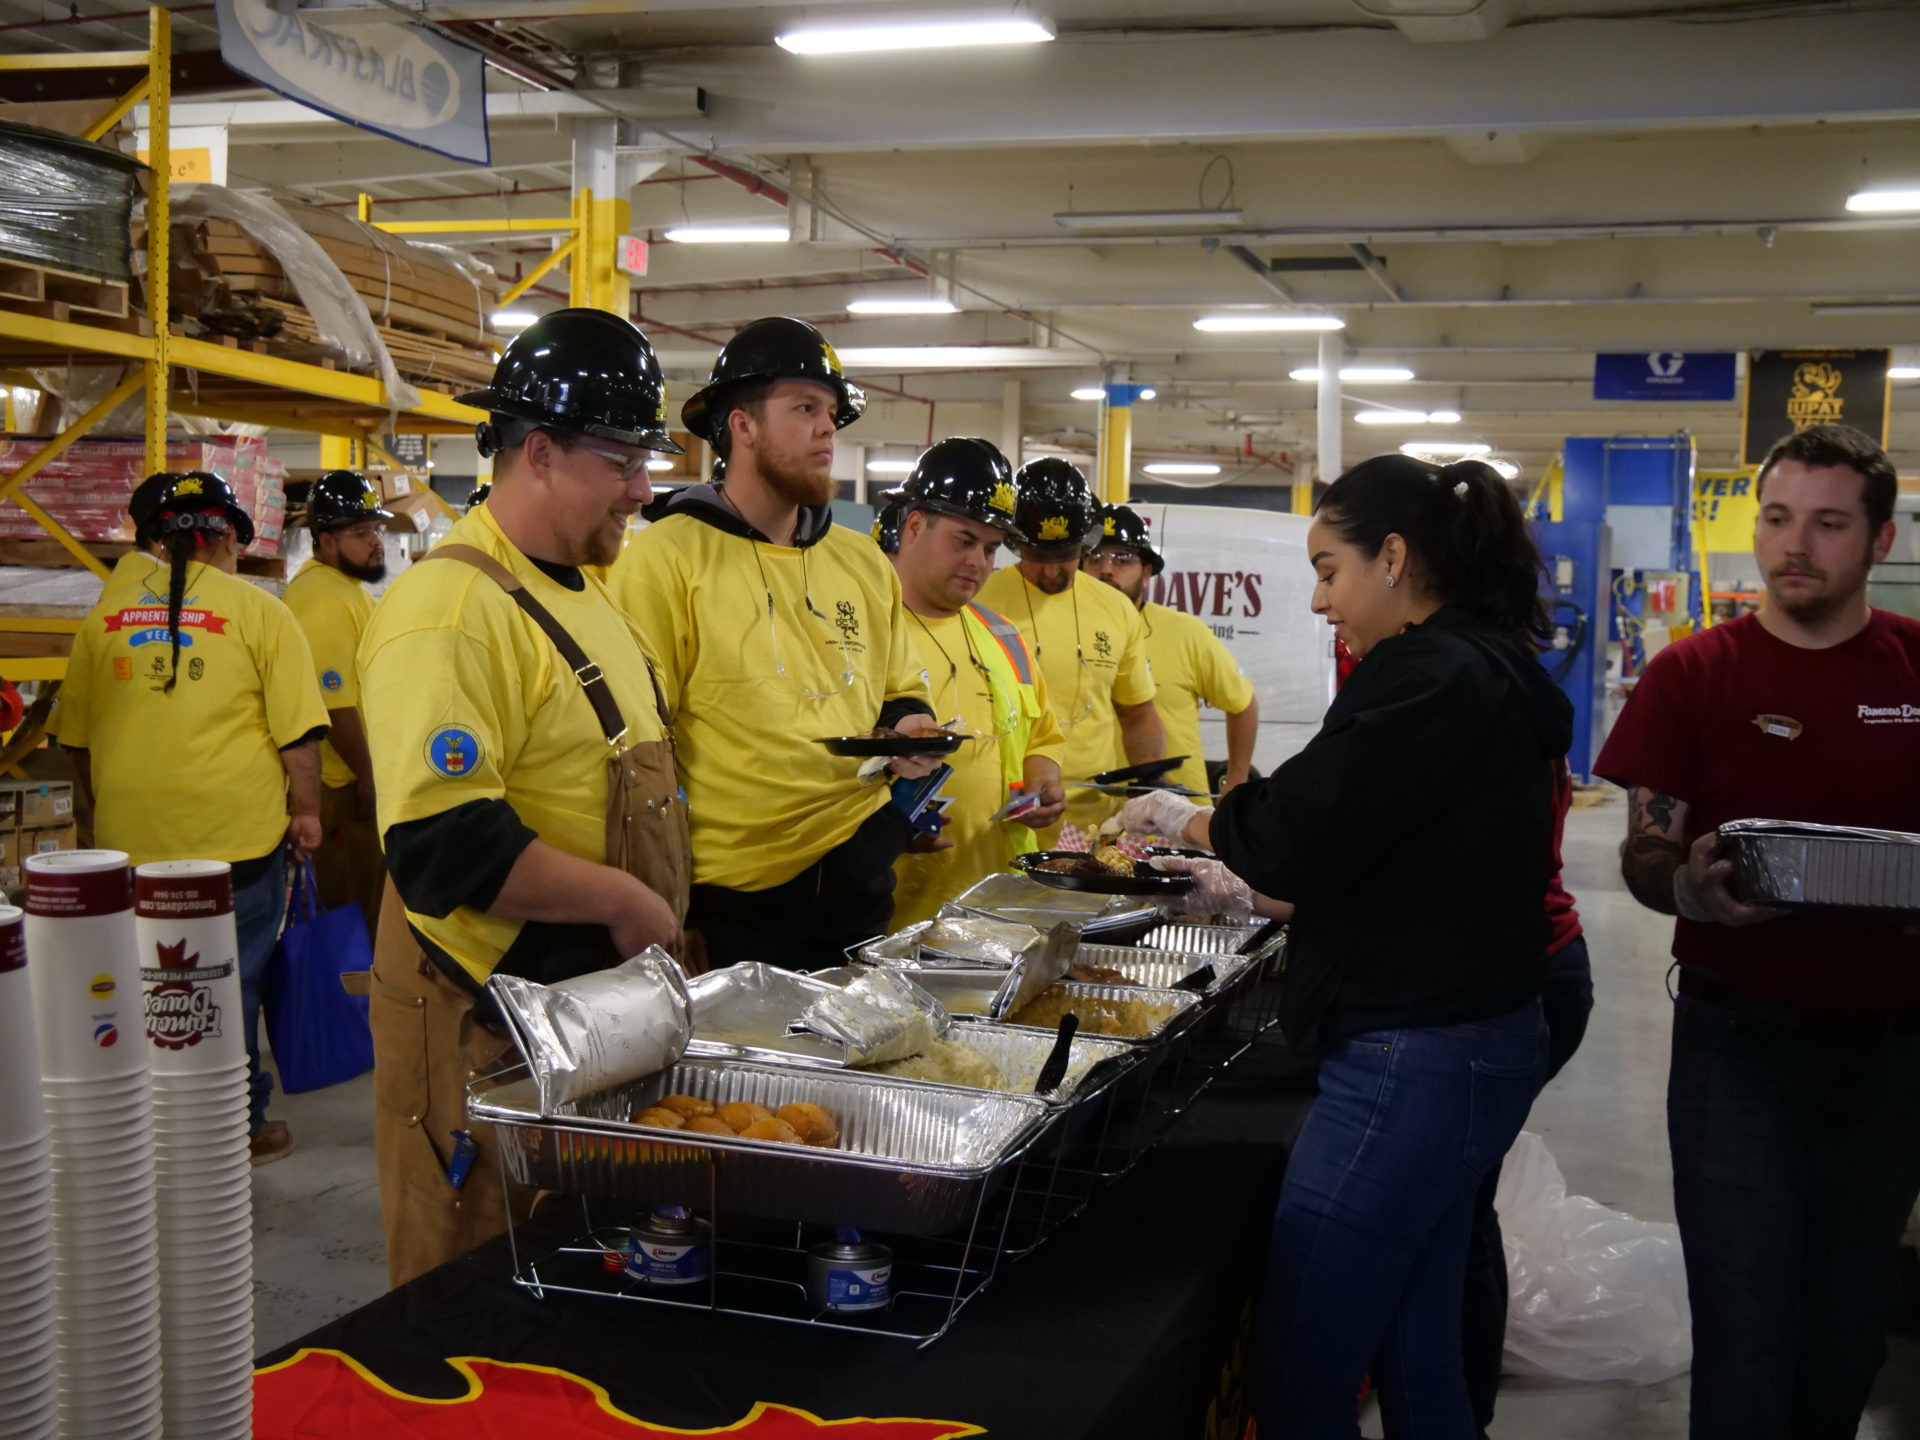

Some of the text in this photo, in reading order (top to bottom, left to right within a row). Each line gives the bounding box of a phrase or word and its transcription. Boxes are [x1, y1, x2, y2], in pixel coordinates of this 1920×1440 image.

[625, 238, 649, 272] EXIT
[1787, 399, 1844, 418] IUPAT
[146, 630, 172, 641] WEE
[140, 900, 216, 912] famousdaves.com
[168, 971, 182, 980] PIT
[183, 968, 224, 980] LEGENDARY
[145, 1007, 222, 1037] Famou
